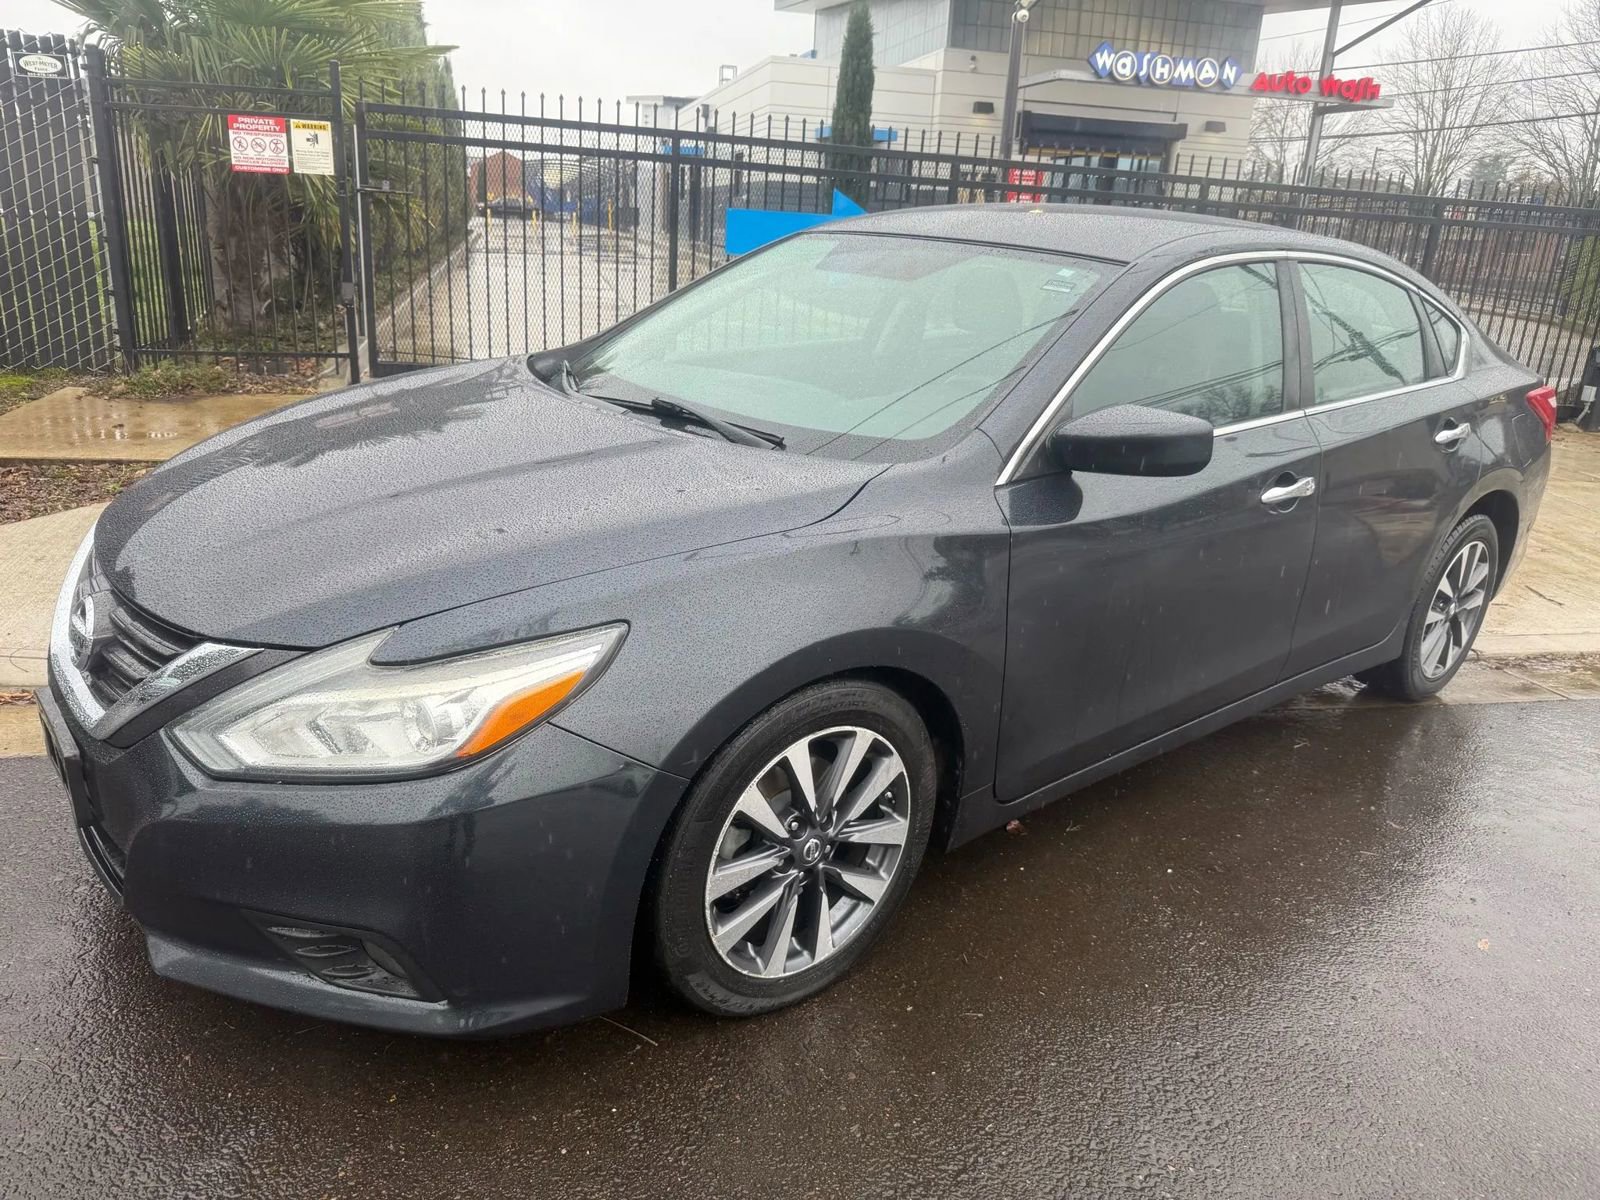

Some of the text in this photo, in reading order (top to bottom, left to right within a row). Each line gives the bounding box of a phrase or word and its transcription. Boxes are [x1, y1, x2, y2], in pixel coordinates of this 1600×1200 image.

[1250, 70, 1313, 95] Auto
[238, 117, 275, 126] PRIVATE
[233, 123, 280, 131] PROPERTY
